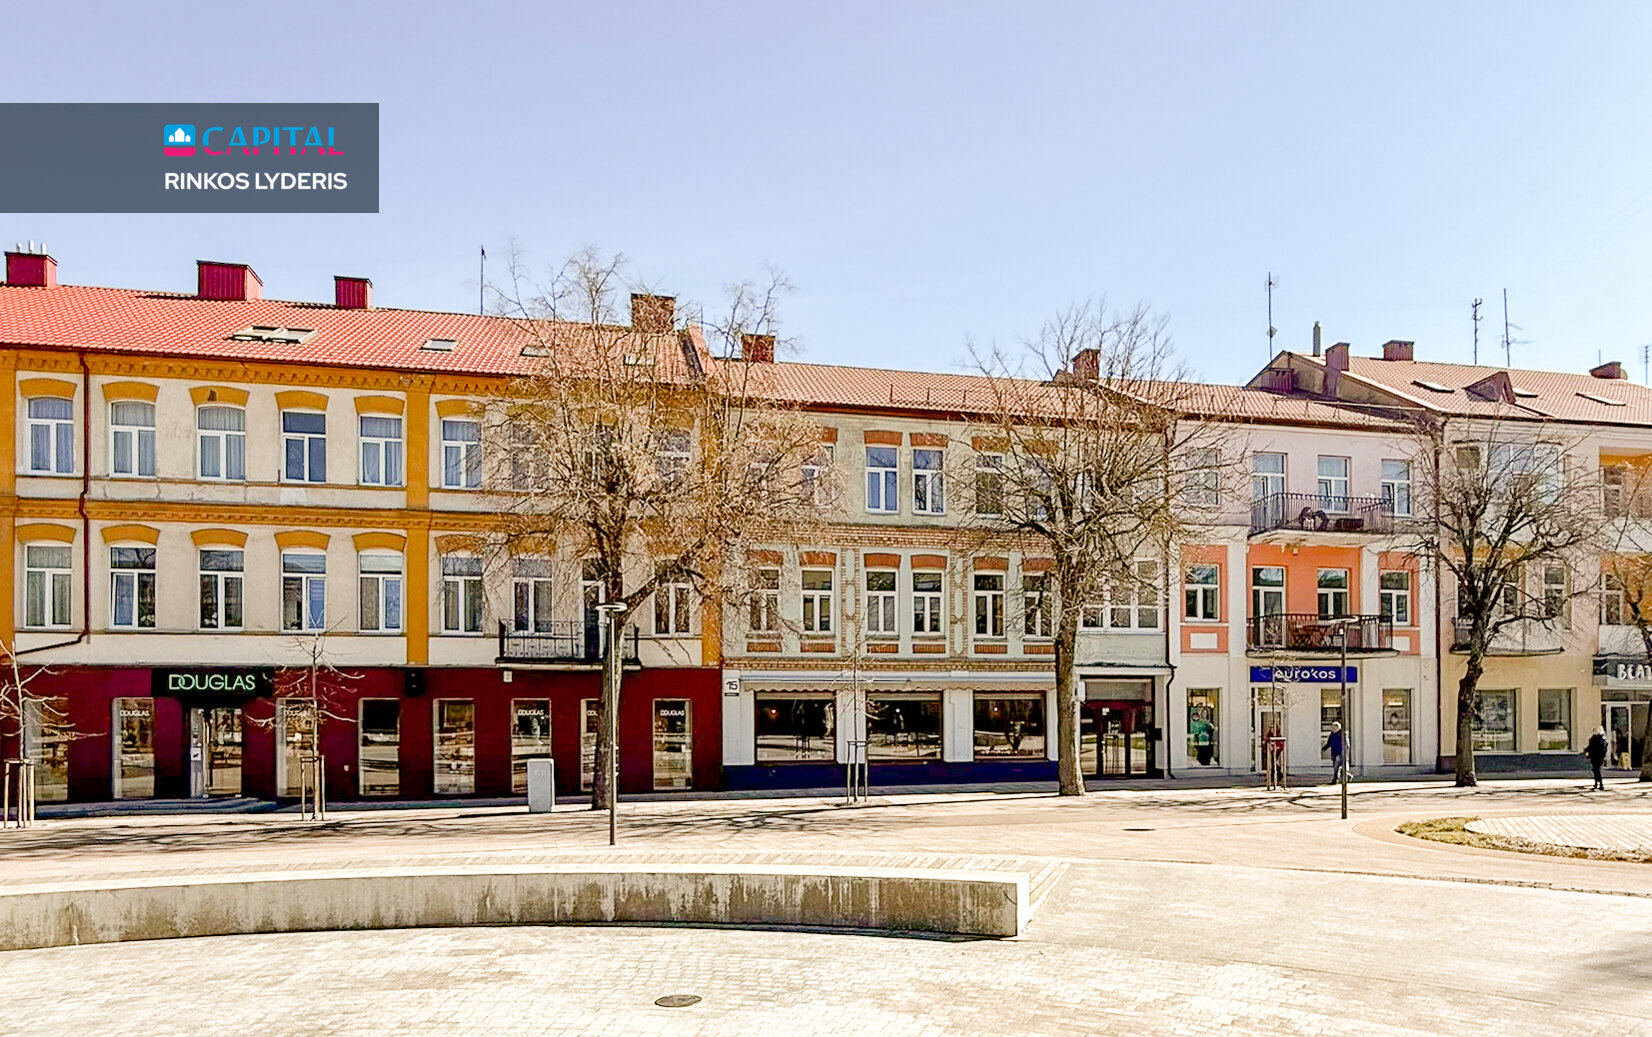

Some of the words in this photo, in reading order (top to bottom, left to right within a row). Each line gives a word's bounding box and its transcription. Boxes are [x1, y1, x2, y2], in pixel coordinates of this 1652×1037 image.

[168, 674, 256, 690] DOUGLAS
[726, 680, 738, 690] 15
[120, 709, 150, 717] DOUGLAS
